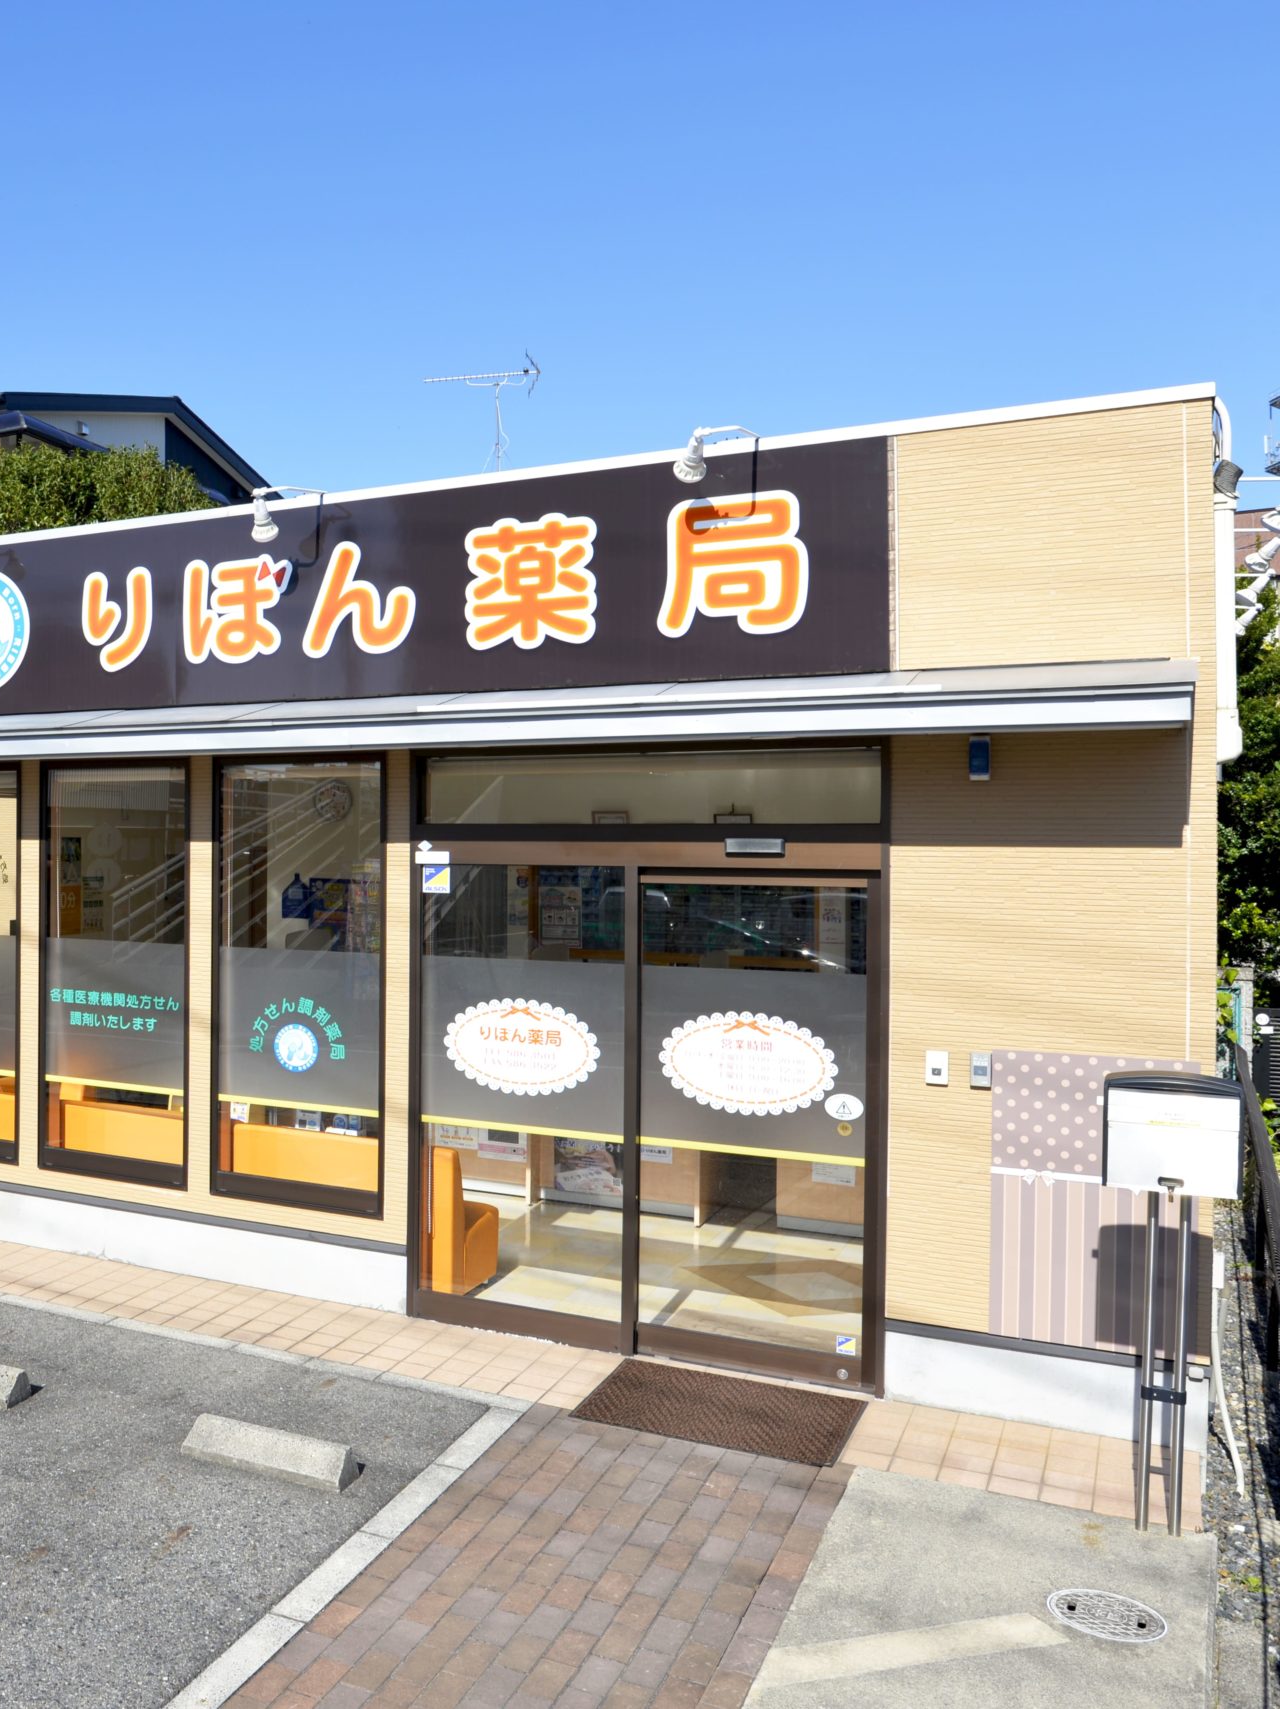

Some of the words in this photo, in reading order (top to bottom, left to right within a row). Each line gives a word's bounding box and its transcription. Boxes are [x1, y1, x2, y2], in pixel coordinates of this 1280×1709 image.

[50, 988, 179, 1011] 各種医療機関処方せん
[69, 1011, 158, 1032] 調剤いたします
[248, 996, 345, 1060] 処方せん調剤薬局
